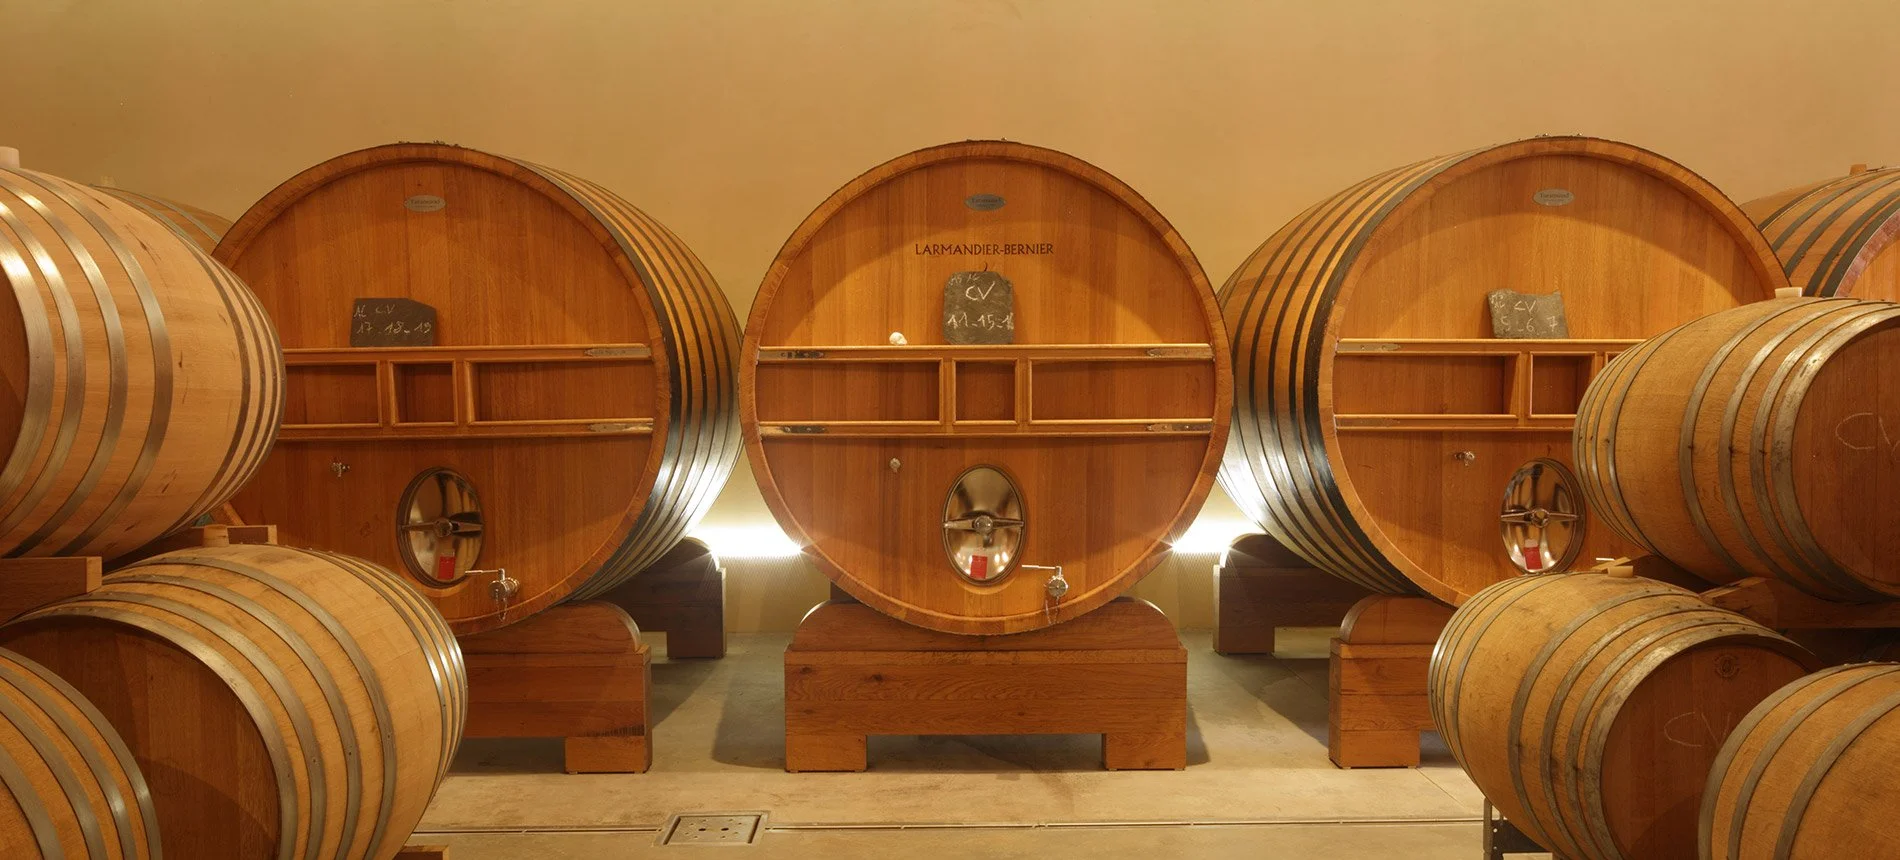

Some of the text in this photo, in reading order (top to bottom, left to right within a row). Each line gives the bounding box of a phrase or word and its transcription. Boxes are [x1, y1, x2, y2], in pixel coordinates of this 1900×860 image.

[915, 243, 1054, 255] LARMANDIER-BERNIER
[965, 281, 996, 301] CV
[1513, 300, 1537, 313] CV
